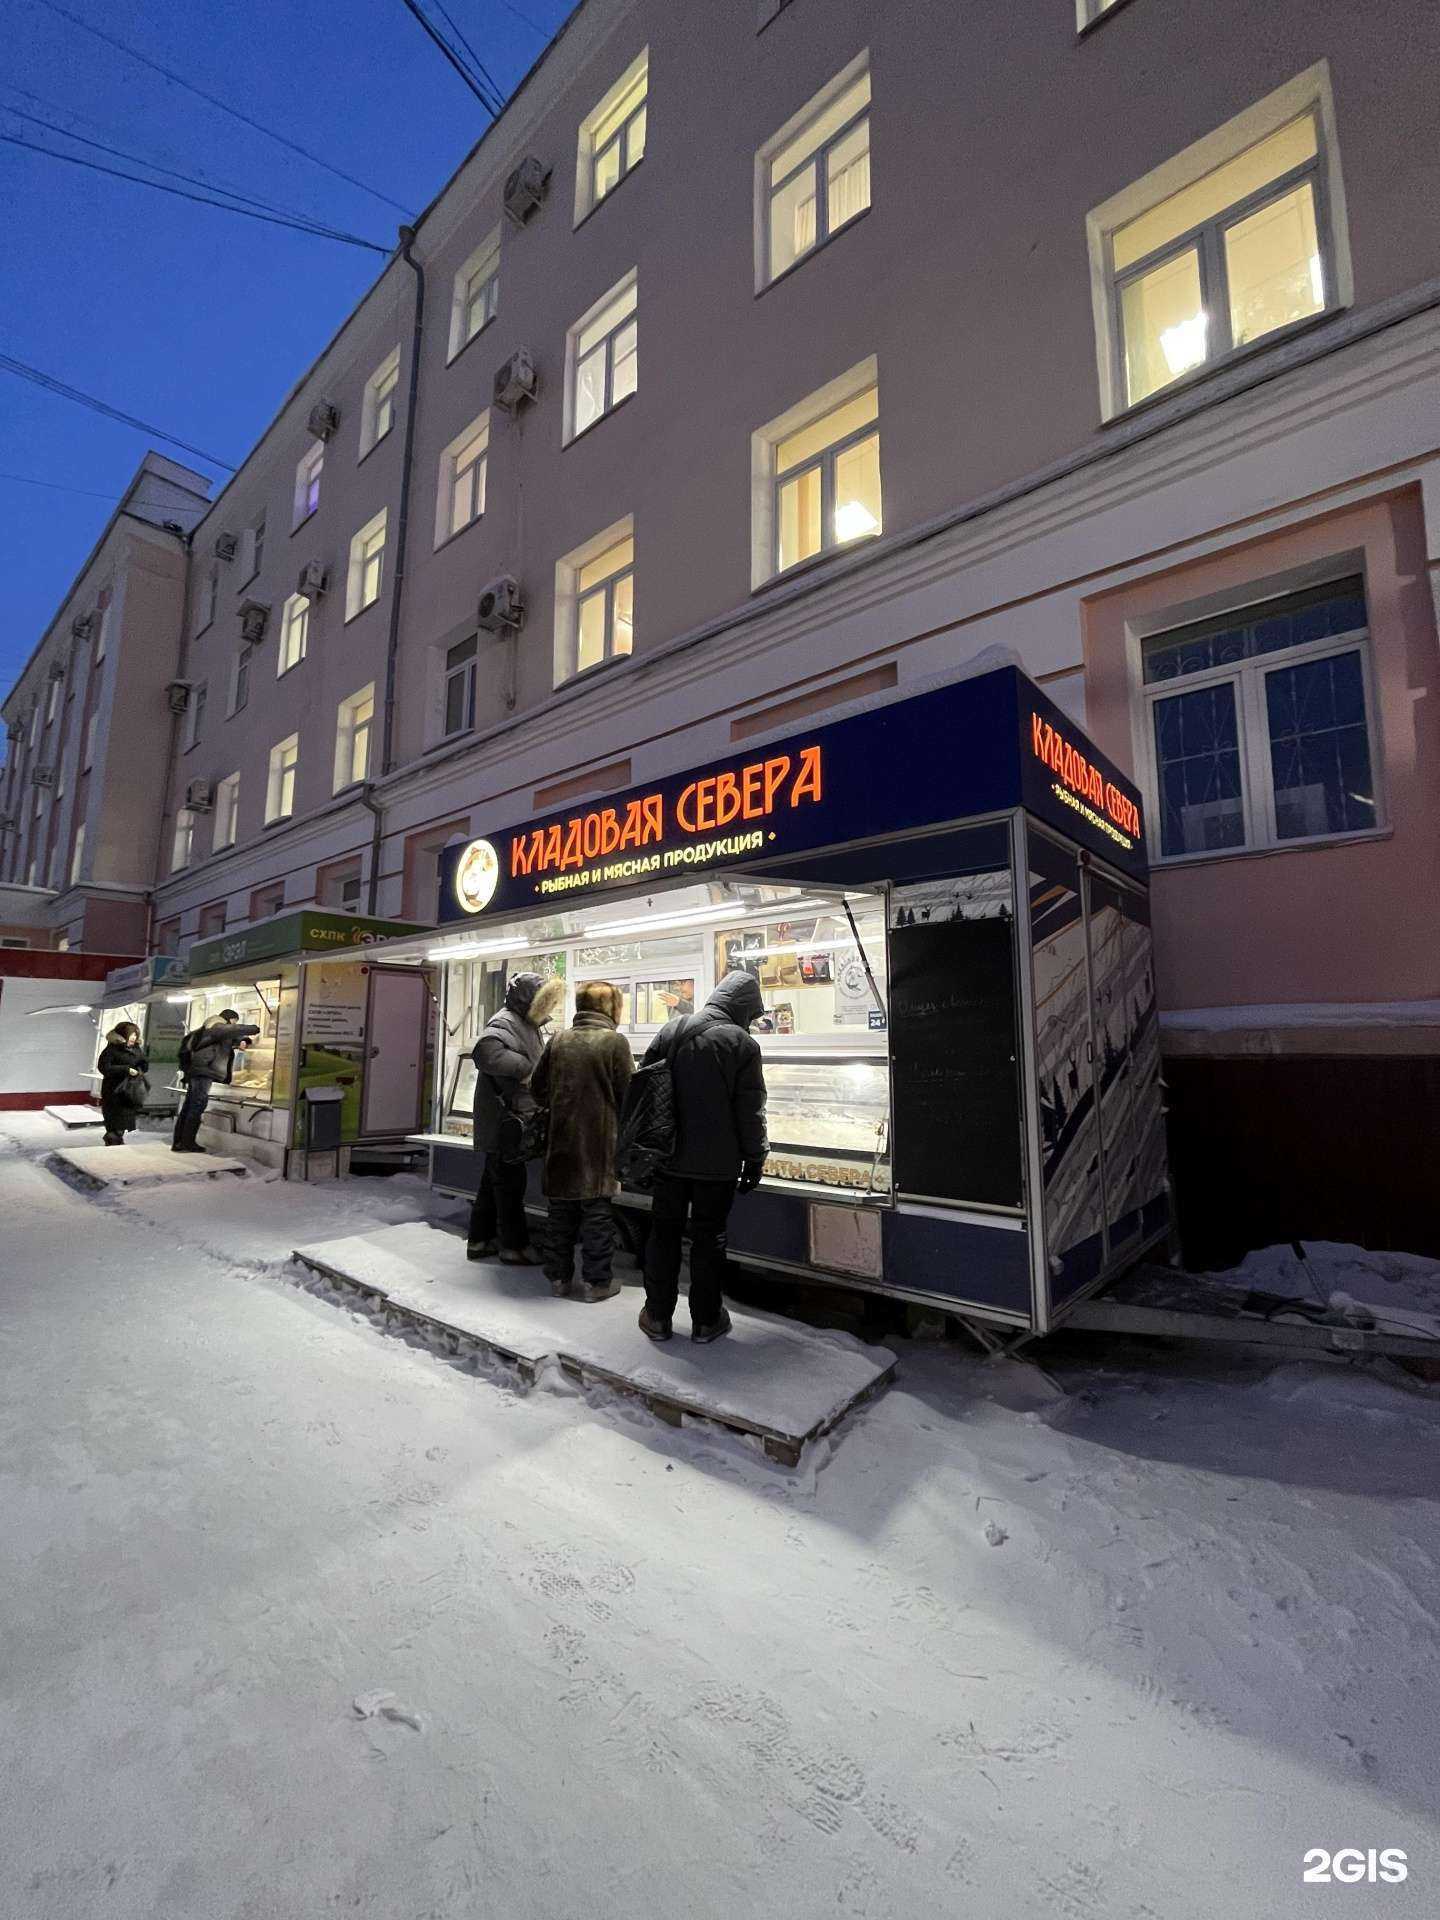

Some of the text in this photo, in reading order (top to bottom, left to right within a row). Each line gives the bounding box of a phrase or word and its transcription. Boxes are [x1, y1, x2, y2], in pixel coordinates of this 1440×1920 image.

[511, 745, 821, 878] КЛАДОВАЯ СЕВЕРА
[1032, 712, 1141, 839] КЛАДОВАЯ СЕВЕРА
[541, 830, 763, 894] РЫБНАЯ И МЯСНАЯ ПРОДУКЦИЯ
